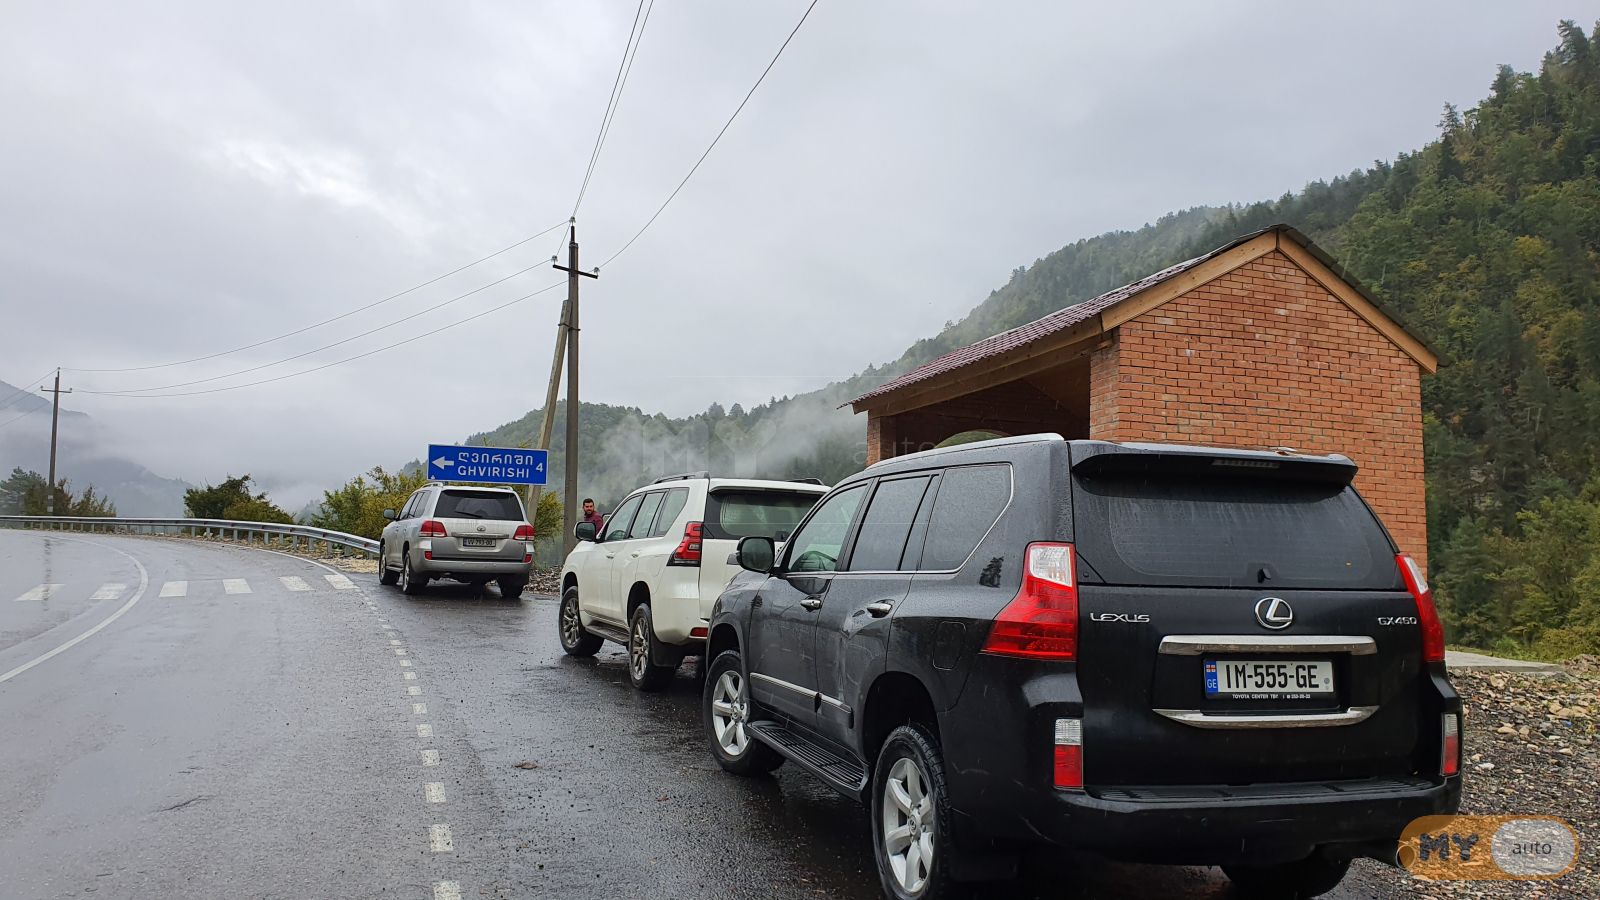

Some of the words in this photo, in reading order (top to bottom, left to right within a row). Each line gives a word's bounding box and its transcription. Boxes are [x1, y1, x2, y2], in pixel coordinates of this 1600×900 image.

[458, 452, 533, 466] ღვირიში
[457, 465, 530, 479] GHVIRISHI
[535, 462, 544, 473] 4
[1090, 612, 1150, 623] LEXUS
[1225, 664, 1320, 689] IM-555-GE
[1206, 678, 1217, 689] GE
